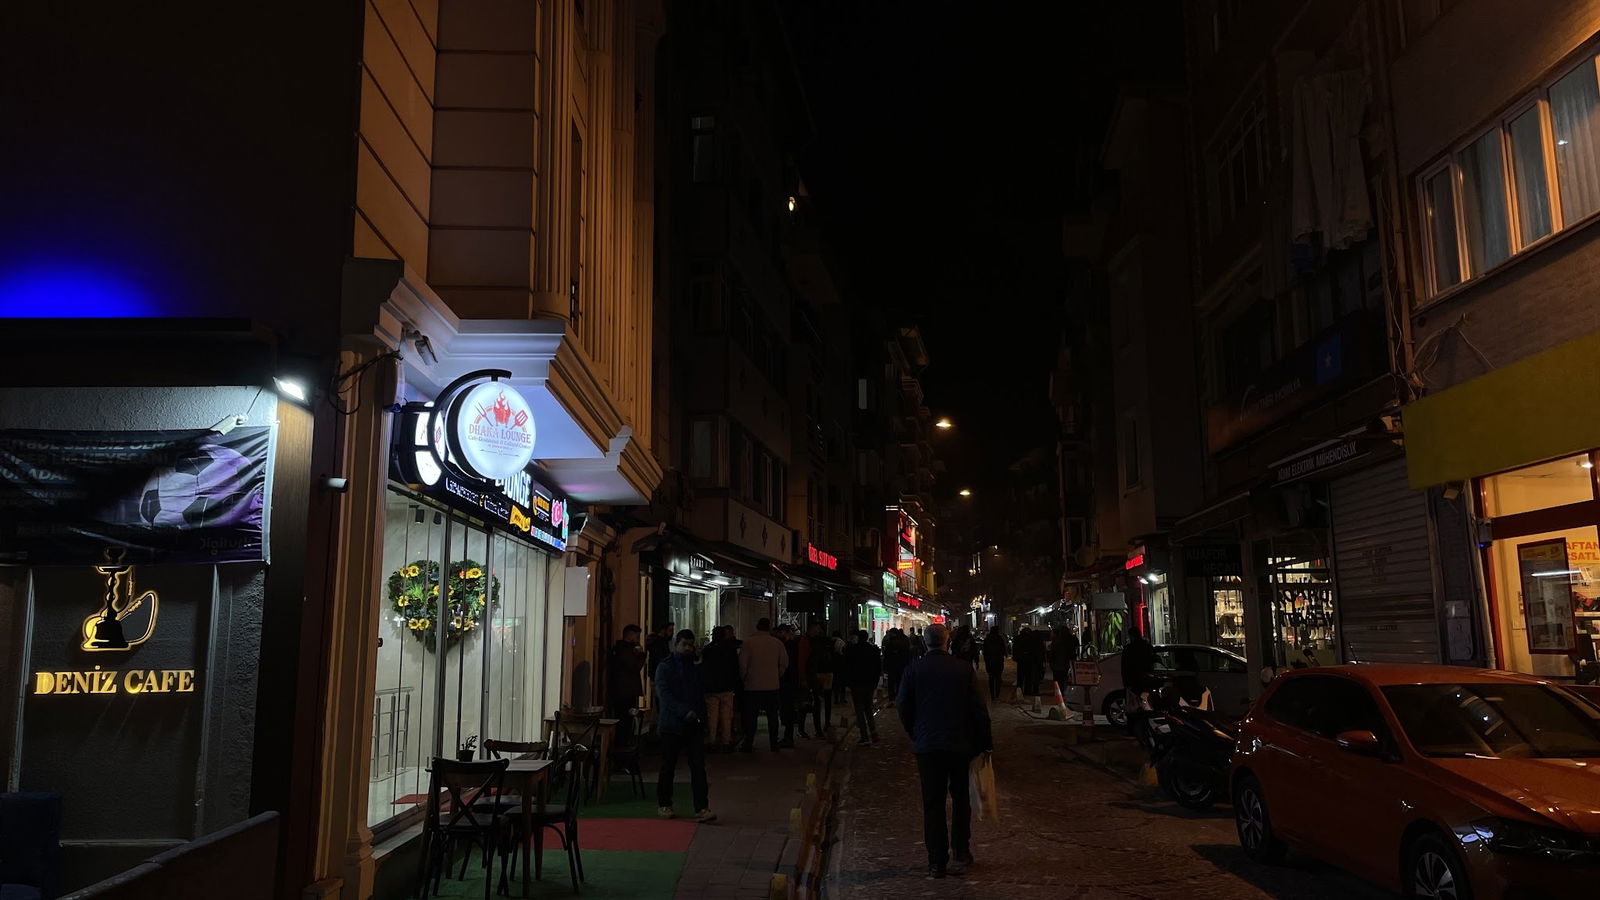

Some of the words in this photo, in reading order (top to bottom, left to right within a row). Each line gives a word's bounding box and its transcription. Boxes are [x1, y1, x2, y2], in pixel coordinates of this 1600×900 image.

[468, 424, 499, 439] DHAKA
[501, 429, 532, 444] LOUNGE
[495, 470, 532, 509] UNGE
[33, 665, 118, 695] DENİZ
[123, 670, 195, 695] CAFE
